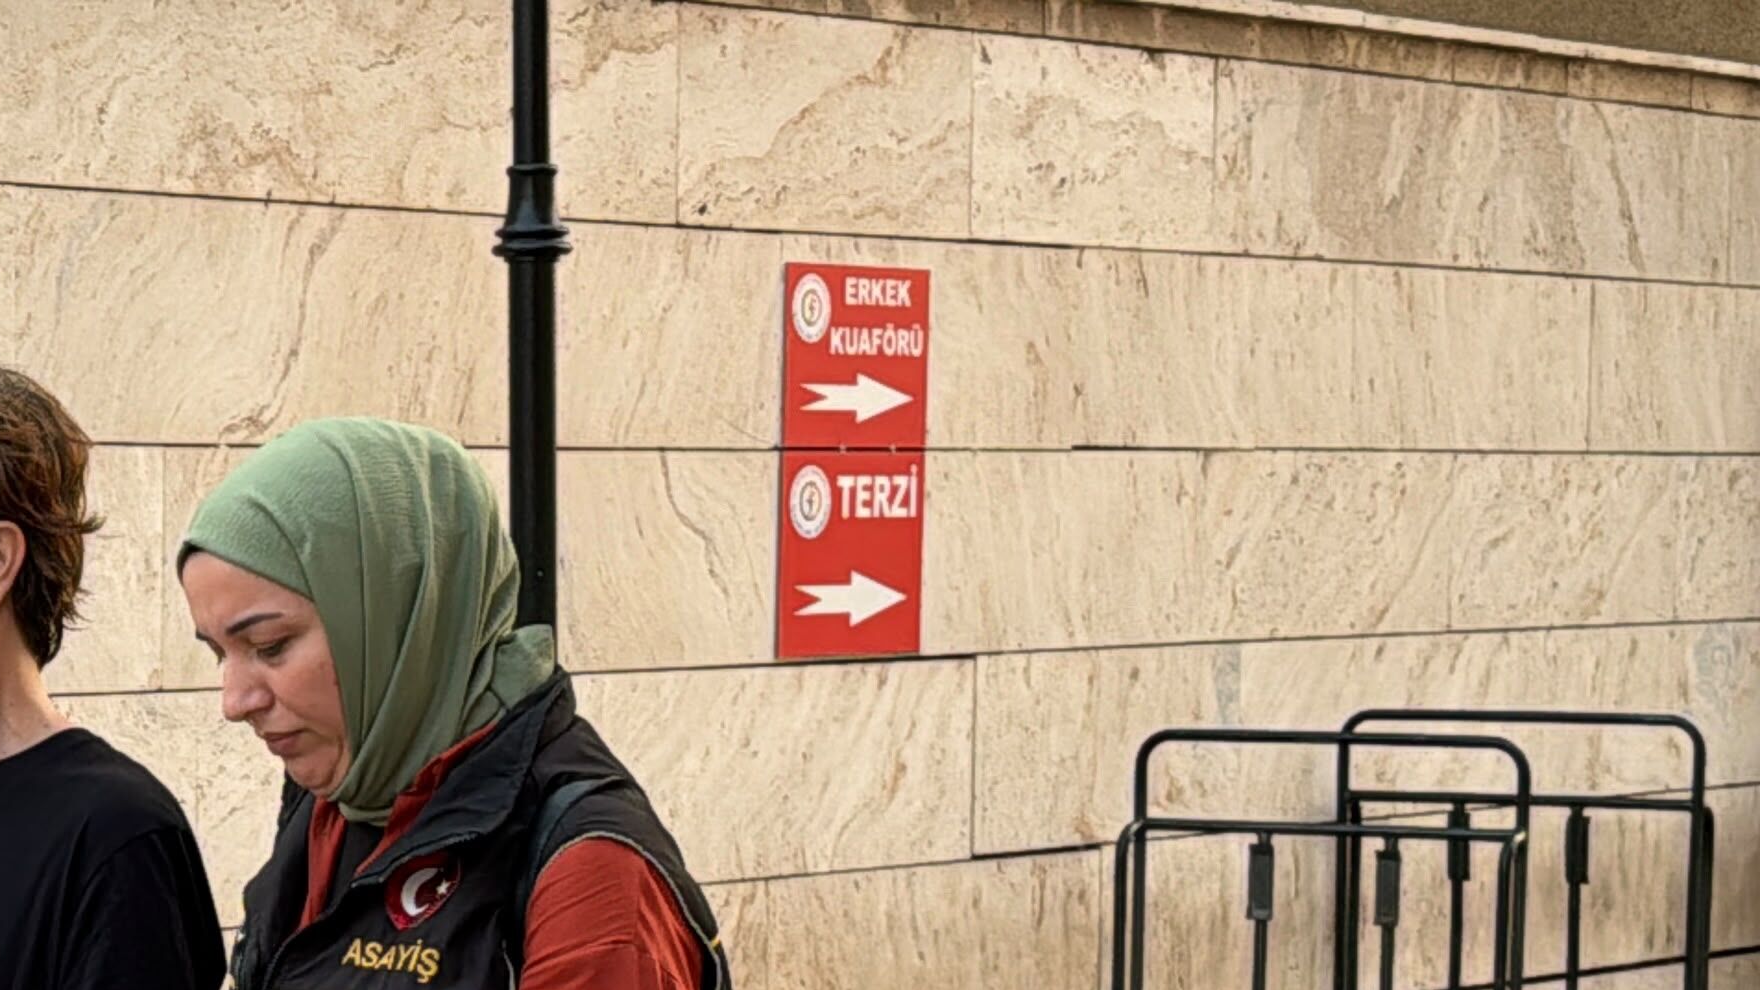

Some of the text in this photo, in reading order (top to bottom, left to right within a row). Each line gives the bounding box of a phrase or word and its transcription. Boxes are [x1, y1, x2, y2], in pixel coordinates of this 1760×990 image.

[845, 276, 912, 307] ERKEK
[829, 322, 924, 357] KUAFÖRÜ
[836, 463, 919, 519] TERZİ
[341, 938, 440, 983] ASAYİŞ
